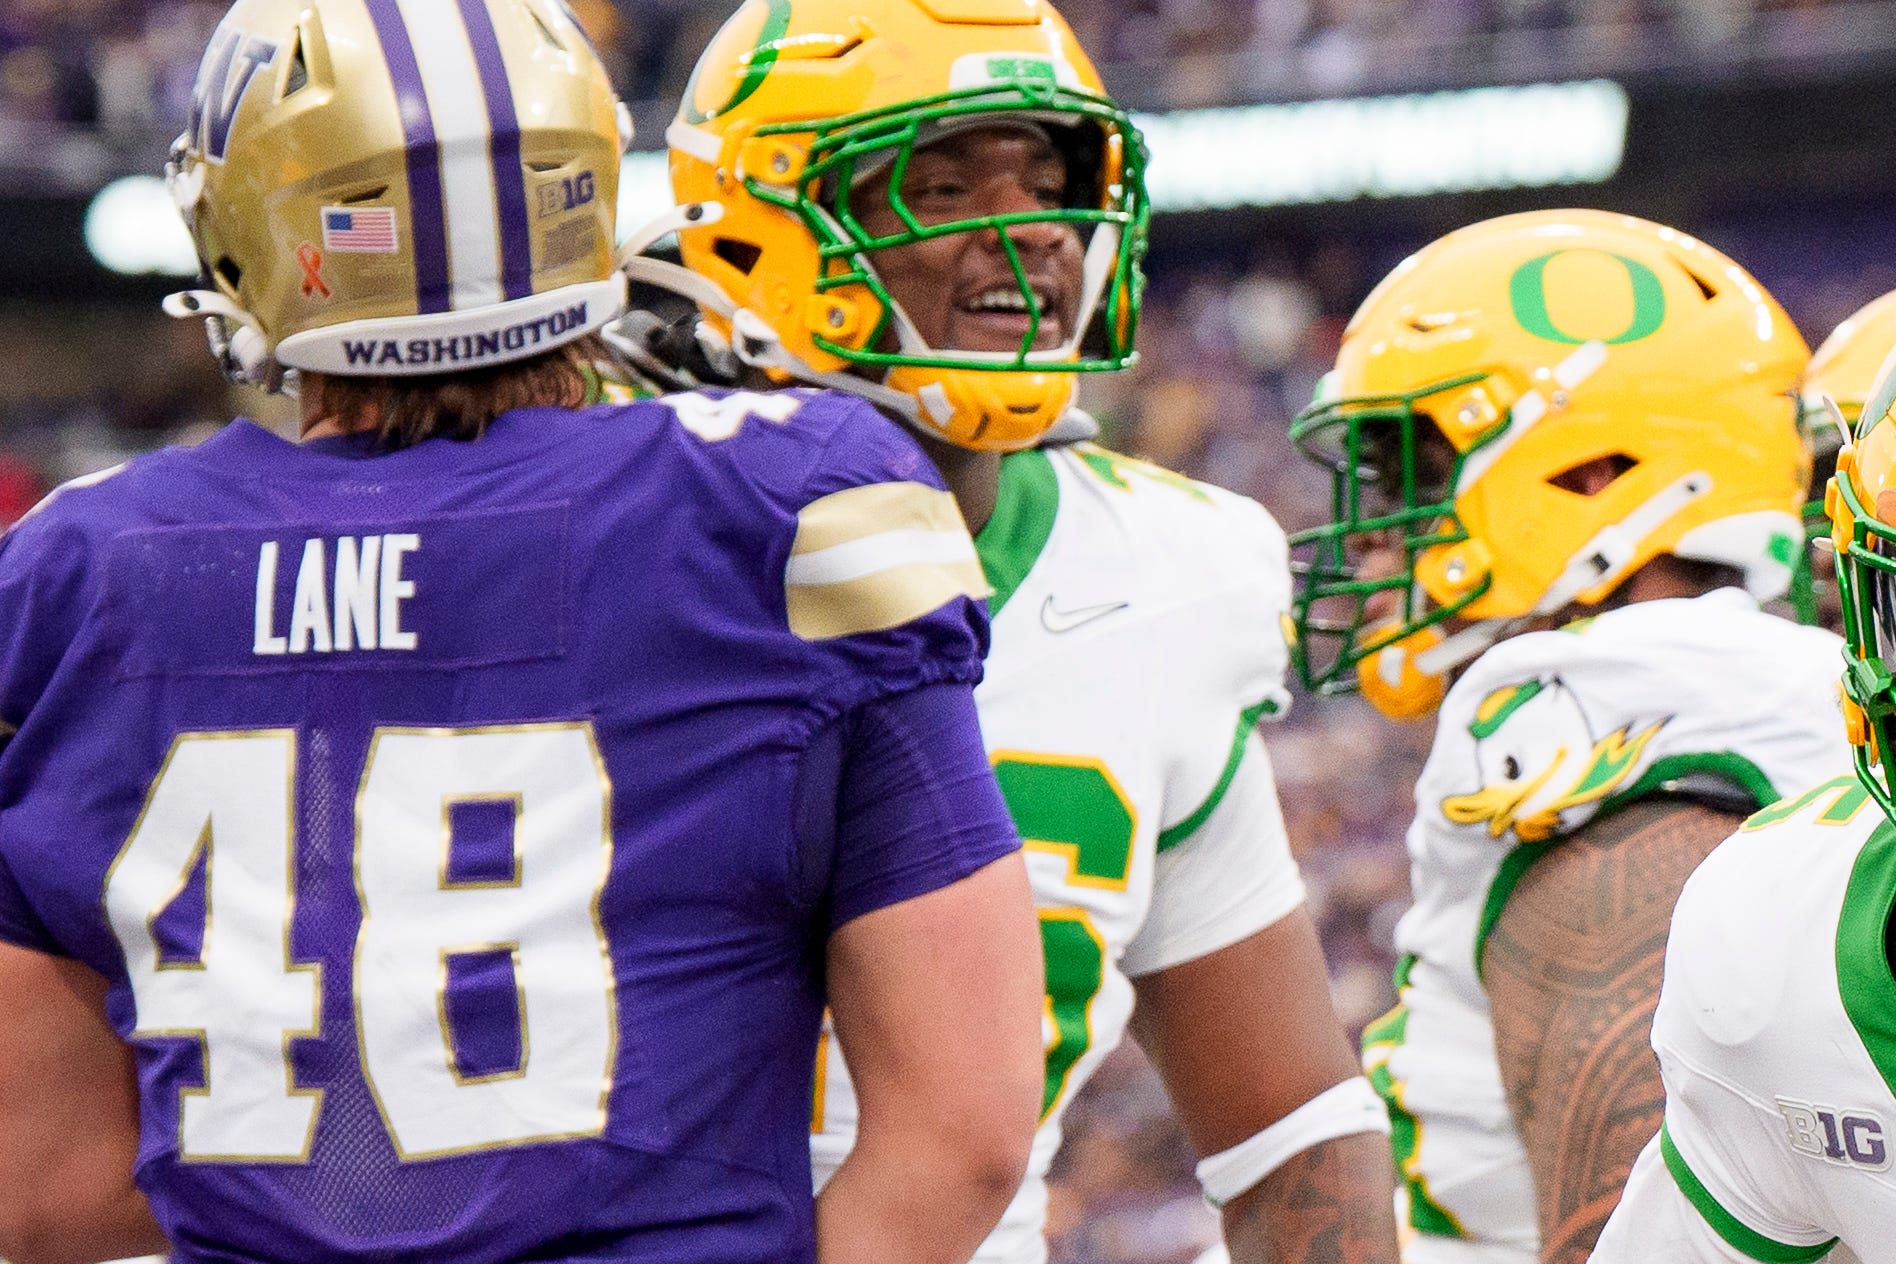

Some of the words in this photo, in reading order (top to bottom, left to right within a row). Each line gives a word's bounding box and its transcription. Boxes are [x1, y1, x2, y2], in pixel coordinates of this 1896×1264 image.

[342, 302, 589, 366] WASHINGTON
[1509, 248, 1665, 346] O
[253, 533, 421, 655] LANE
[104, 719, 619, 1163] 48
